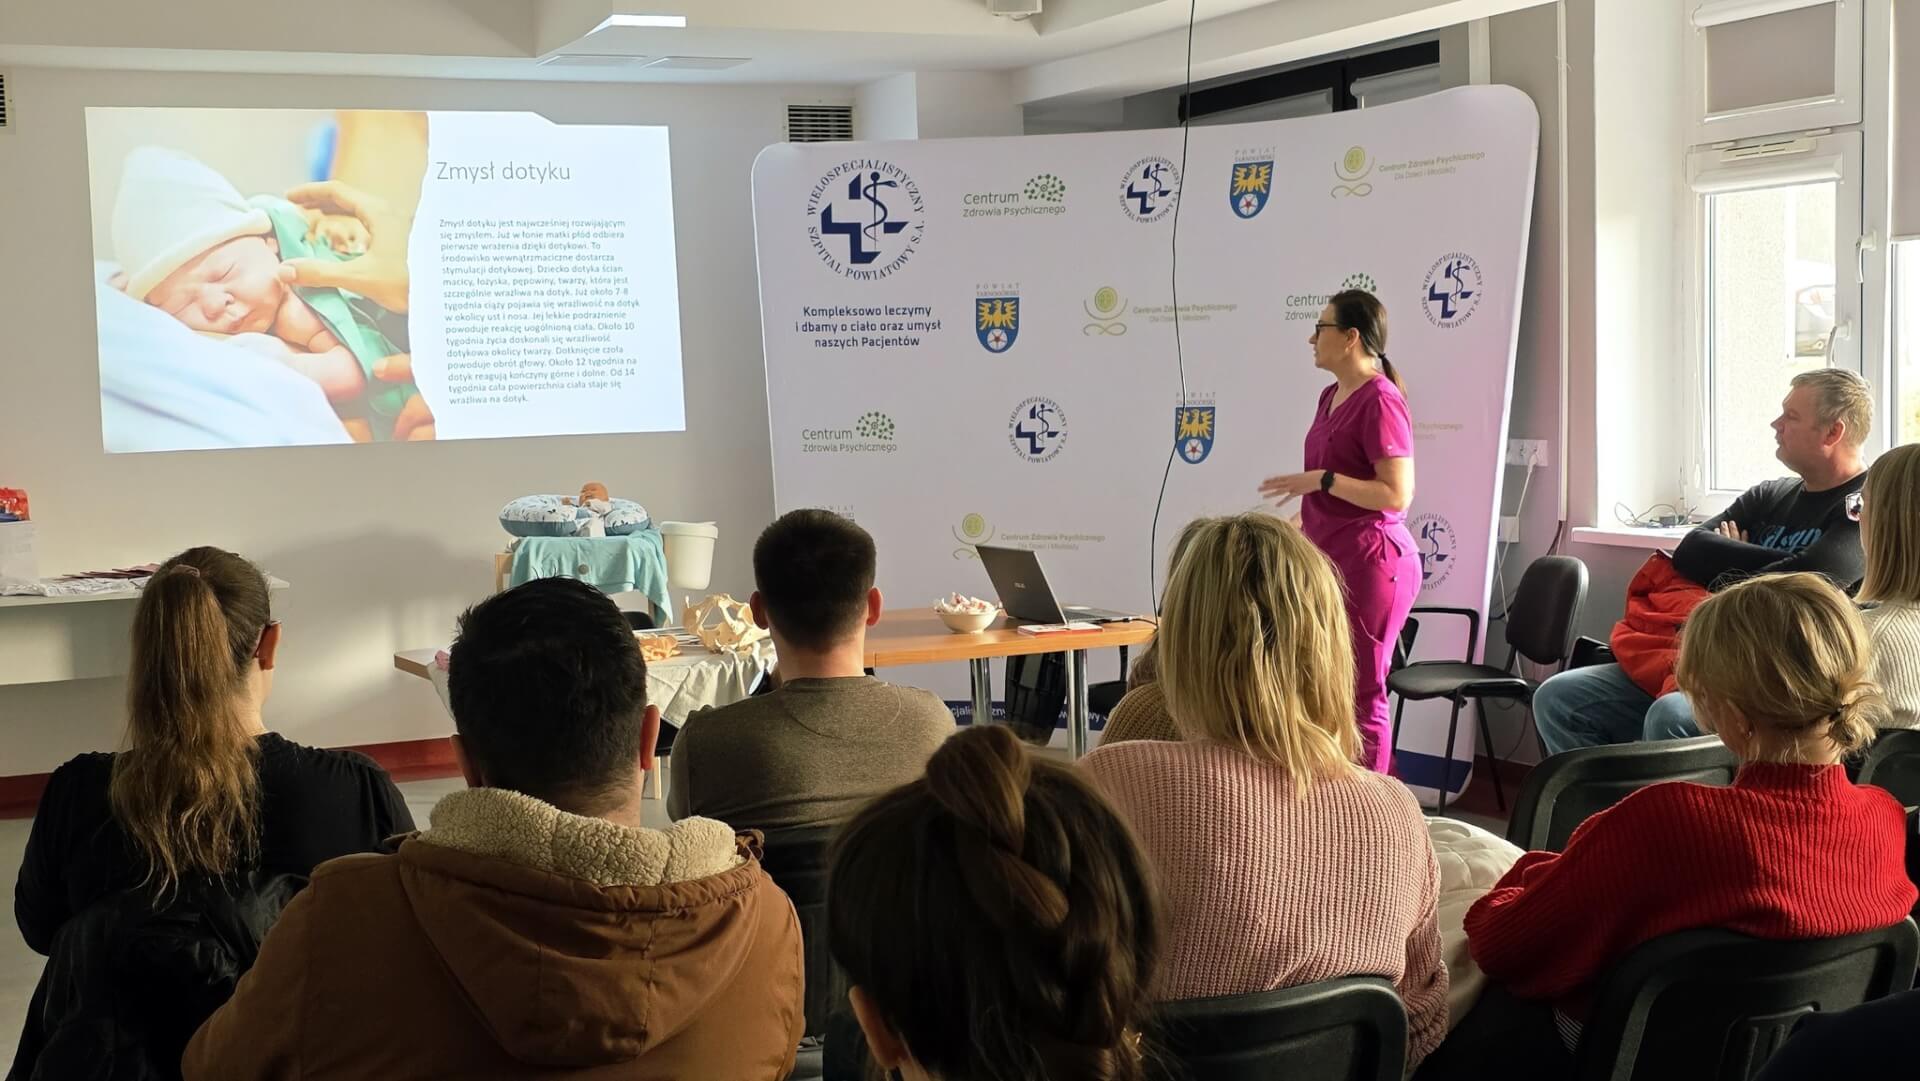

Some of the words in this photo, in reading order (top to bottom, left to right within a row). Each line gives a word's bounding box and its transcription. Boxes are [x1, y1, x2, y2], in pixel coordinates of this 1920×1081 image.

[436, 161, 494, 184] Zmysł
[502, 161, 571, 184] dotyku
[808, 159, 924, 216] WIELOSPECJALISTYCZNY
[964, 192, 1019, 205] Centrum
[963, 208, 1001, 217] Zdrowia
[1004, 206, 1066, 216] Psychicznego
[467, 219, 496, 228] dotyku
[499, 220, 513, 228] jest
[516, 218, 569, 228] najwcześniej
[572, 219, 625, 228] rozwijającym
[440, 231, 452, 240] się
[455, 231, 492, 239] zmysłem.
[497, 231, 510, 239] Już
[572, 230, 590, 239] płód
[441, 243, 478, 252] pierwsze
[522, 242, 546, 251] dzięki
[548, 242, 589, 251] dotykowi.
[442, 253, 490, 262] środowisko
[493, 253, 573, 263] wewnątrzmaciczne
[808, 226, 842, 274] SZPITAL
[844, 245, 916, 280] POWIATOWY
[442, 266, 486, 275] stymulacji
[488, 265, 534, 274] dotykowej.
[572, 265, 599, 274] dotyka
[443, 278, 474, 287] macicy,
[477, 277, 510, 286] łożyska,
[513, 278, 555, 286] pępowiny,
[558, 277, 587, 286] twarzy,
[613, 276, 628, 285] jest
[444, 289, 491, 298] szczególnie
[494, 288, 531, 297] wrażliwa
[547, 288, 572, 298] dotyk.
[444, 302, 482, 311] tygodnia
[484, 302, 504, 310] ciąży
[508, 301, 540, 310] pojawia
[543, 301, 554, 309] się
[557, 300, 602, 308] wrażliwość
[616, 299, 639, 308] dotyk
[455, 313, 484, 322] okolicy
[532, 312, 543, 321] Jej
[546, 311, 570, 319] lekkie
[573, 311, 626, 320] podrażnienie
[803, 306, 882, 318] Kompleksowo
[884, 305, 932, 318] leczymy
[446, 325, 488, 334] powoduje
[491, 325, 521, 334] reakcję
[524, 324, 571, 333] uogólnioną
[574, 323, 595, 331] ciała.
[802, 321, 838, 334] dbamy
[850, 321, 876, 332] ciało
[907, 320, 941, 332] umysł
[446, 337, 483, 346] tygodnia
[487, 336, 506, 345] życia
[509, 336, 549, 344] doskonali
[552, 335, 563, 344] się
[566, 335, 611, 343] wrażliwość
[815, 337, 858, 350] naszych
[861, 336, 920, 348] Pacjentów
[447, 349, 489, 358] dotykowa
[492, 348, 521, 357] okolicy
[448, 361, 490, 370] powoduje
[494, 360, 516, 368] obrót
[519, 360, 547, 368] głowy.
[588, 358, 624, 367] tygodnia
[448, 373, 472, 382] dotyk
[475, 372, 507, 381] reagują
[510, 370, 548, 380] kończyny
[551, 370, 574, 379] górne
[449, 384, 486, 394] tygodnia
[508, 382, 564, 392] powierzchnia
[589, 381, 608, 390] staje
[611, 381, 621, 389] się
[450, 396, 487, 404] wrażliwa
[503, 395, 528, 404] dotyk.
[802, 429, 852, 440] Centrum
[803, 444, 837, 452] Zdrowia
[840, 443, 897, 453] Psychicznego
